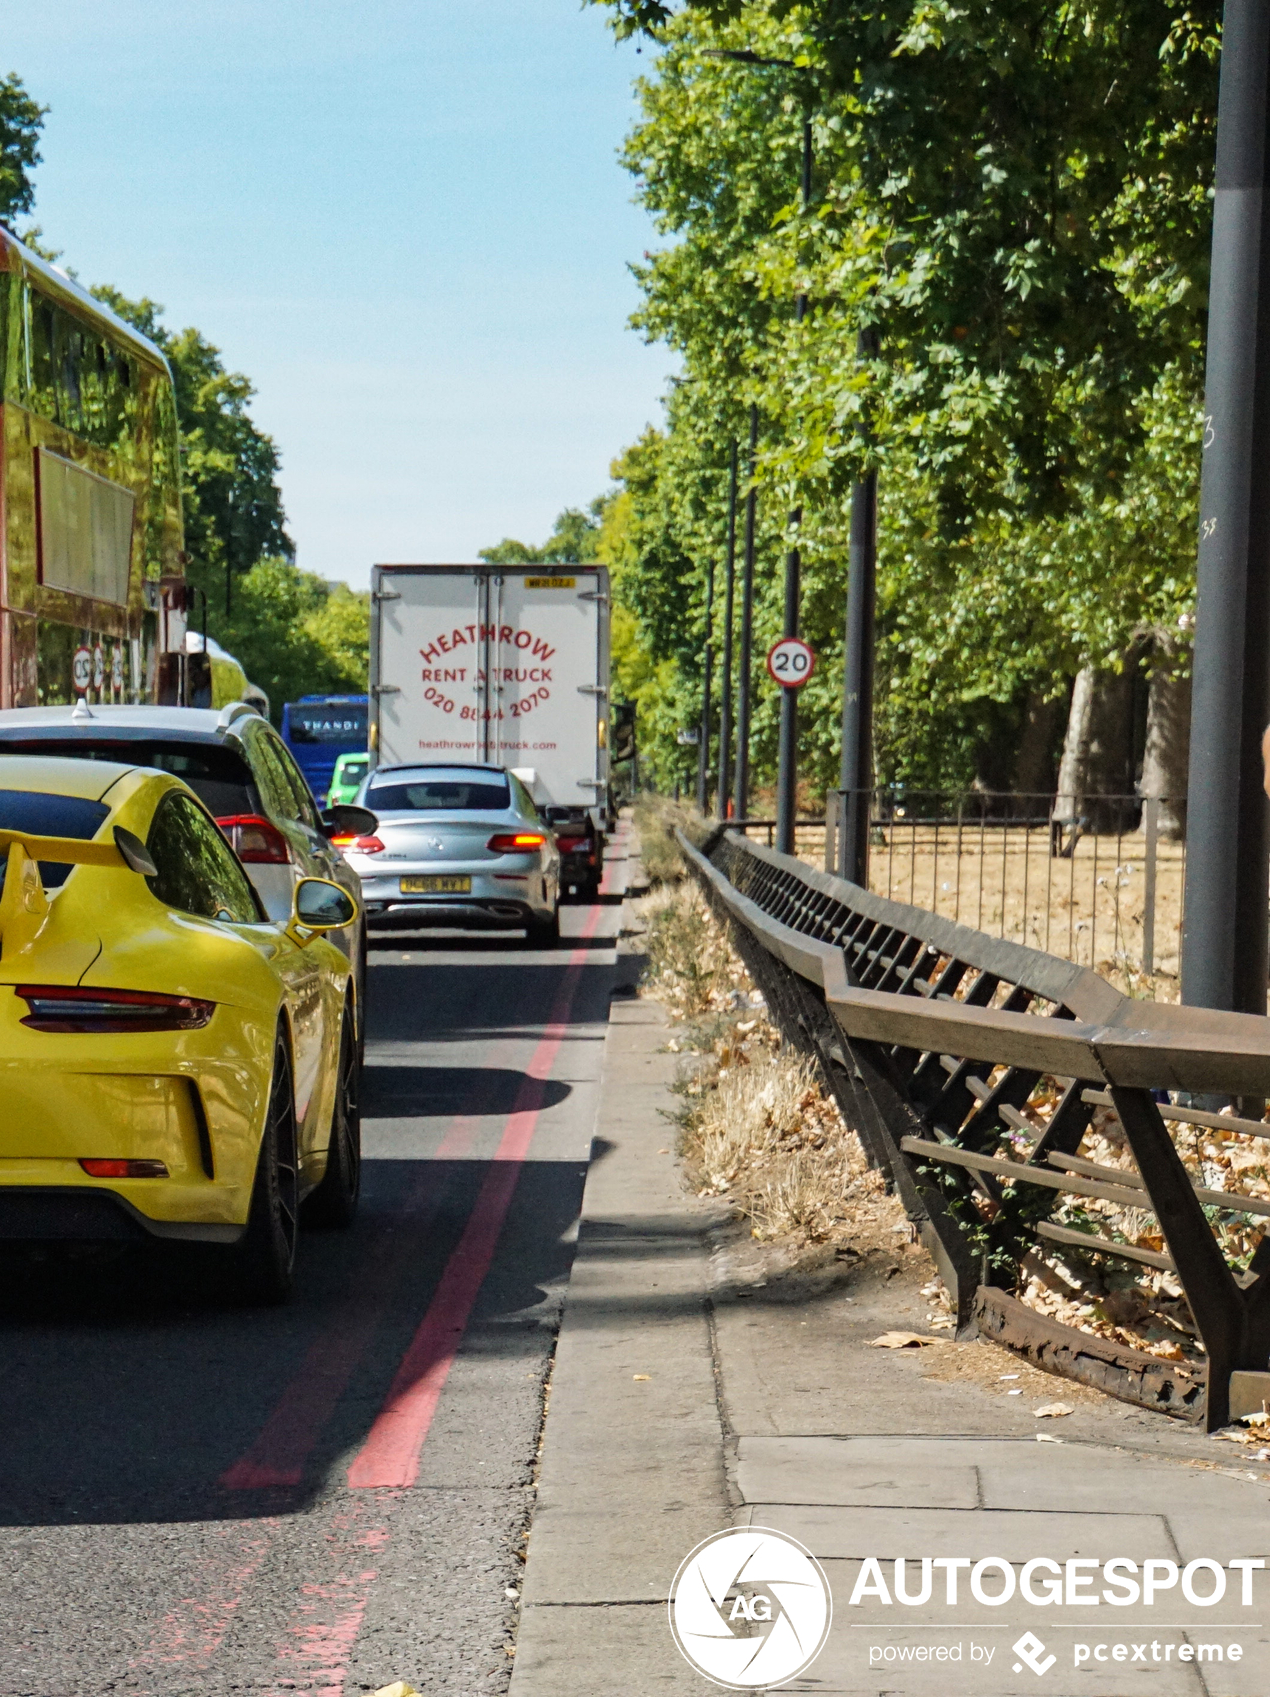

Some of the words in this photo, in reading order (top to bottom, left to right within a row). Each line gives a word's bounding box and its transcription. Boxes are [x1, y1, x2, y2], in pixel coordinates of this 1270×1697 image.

[419, 624, 556, 664] HEATHROW
[775, 652, 808, 672] 20
[422, 668, 467, 682] RENT
[492, 668, 553, 682] TRUCK
[424, 687, 455, 713] 020
[510, 687, 550, 717] 2070
